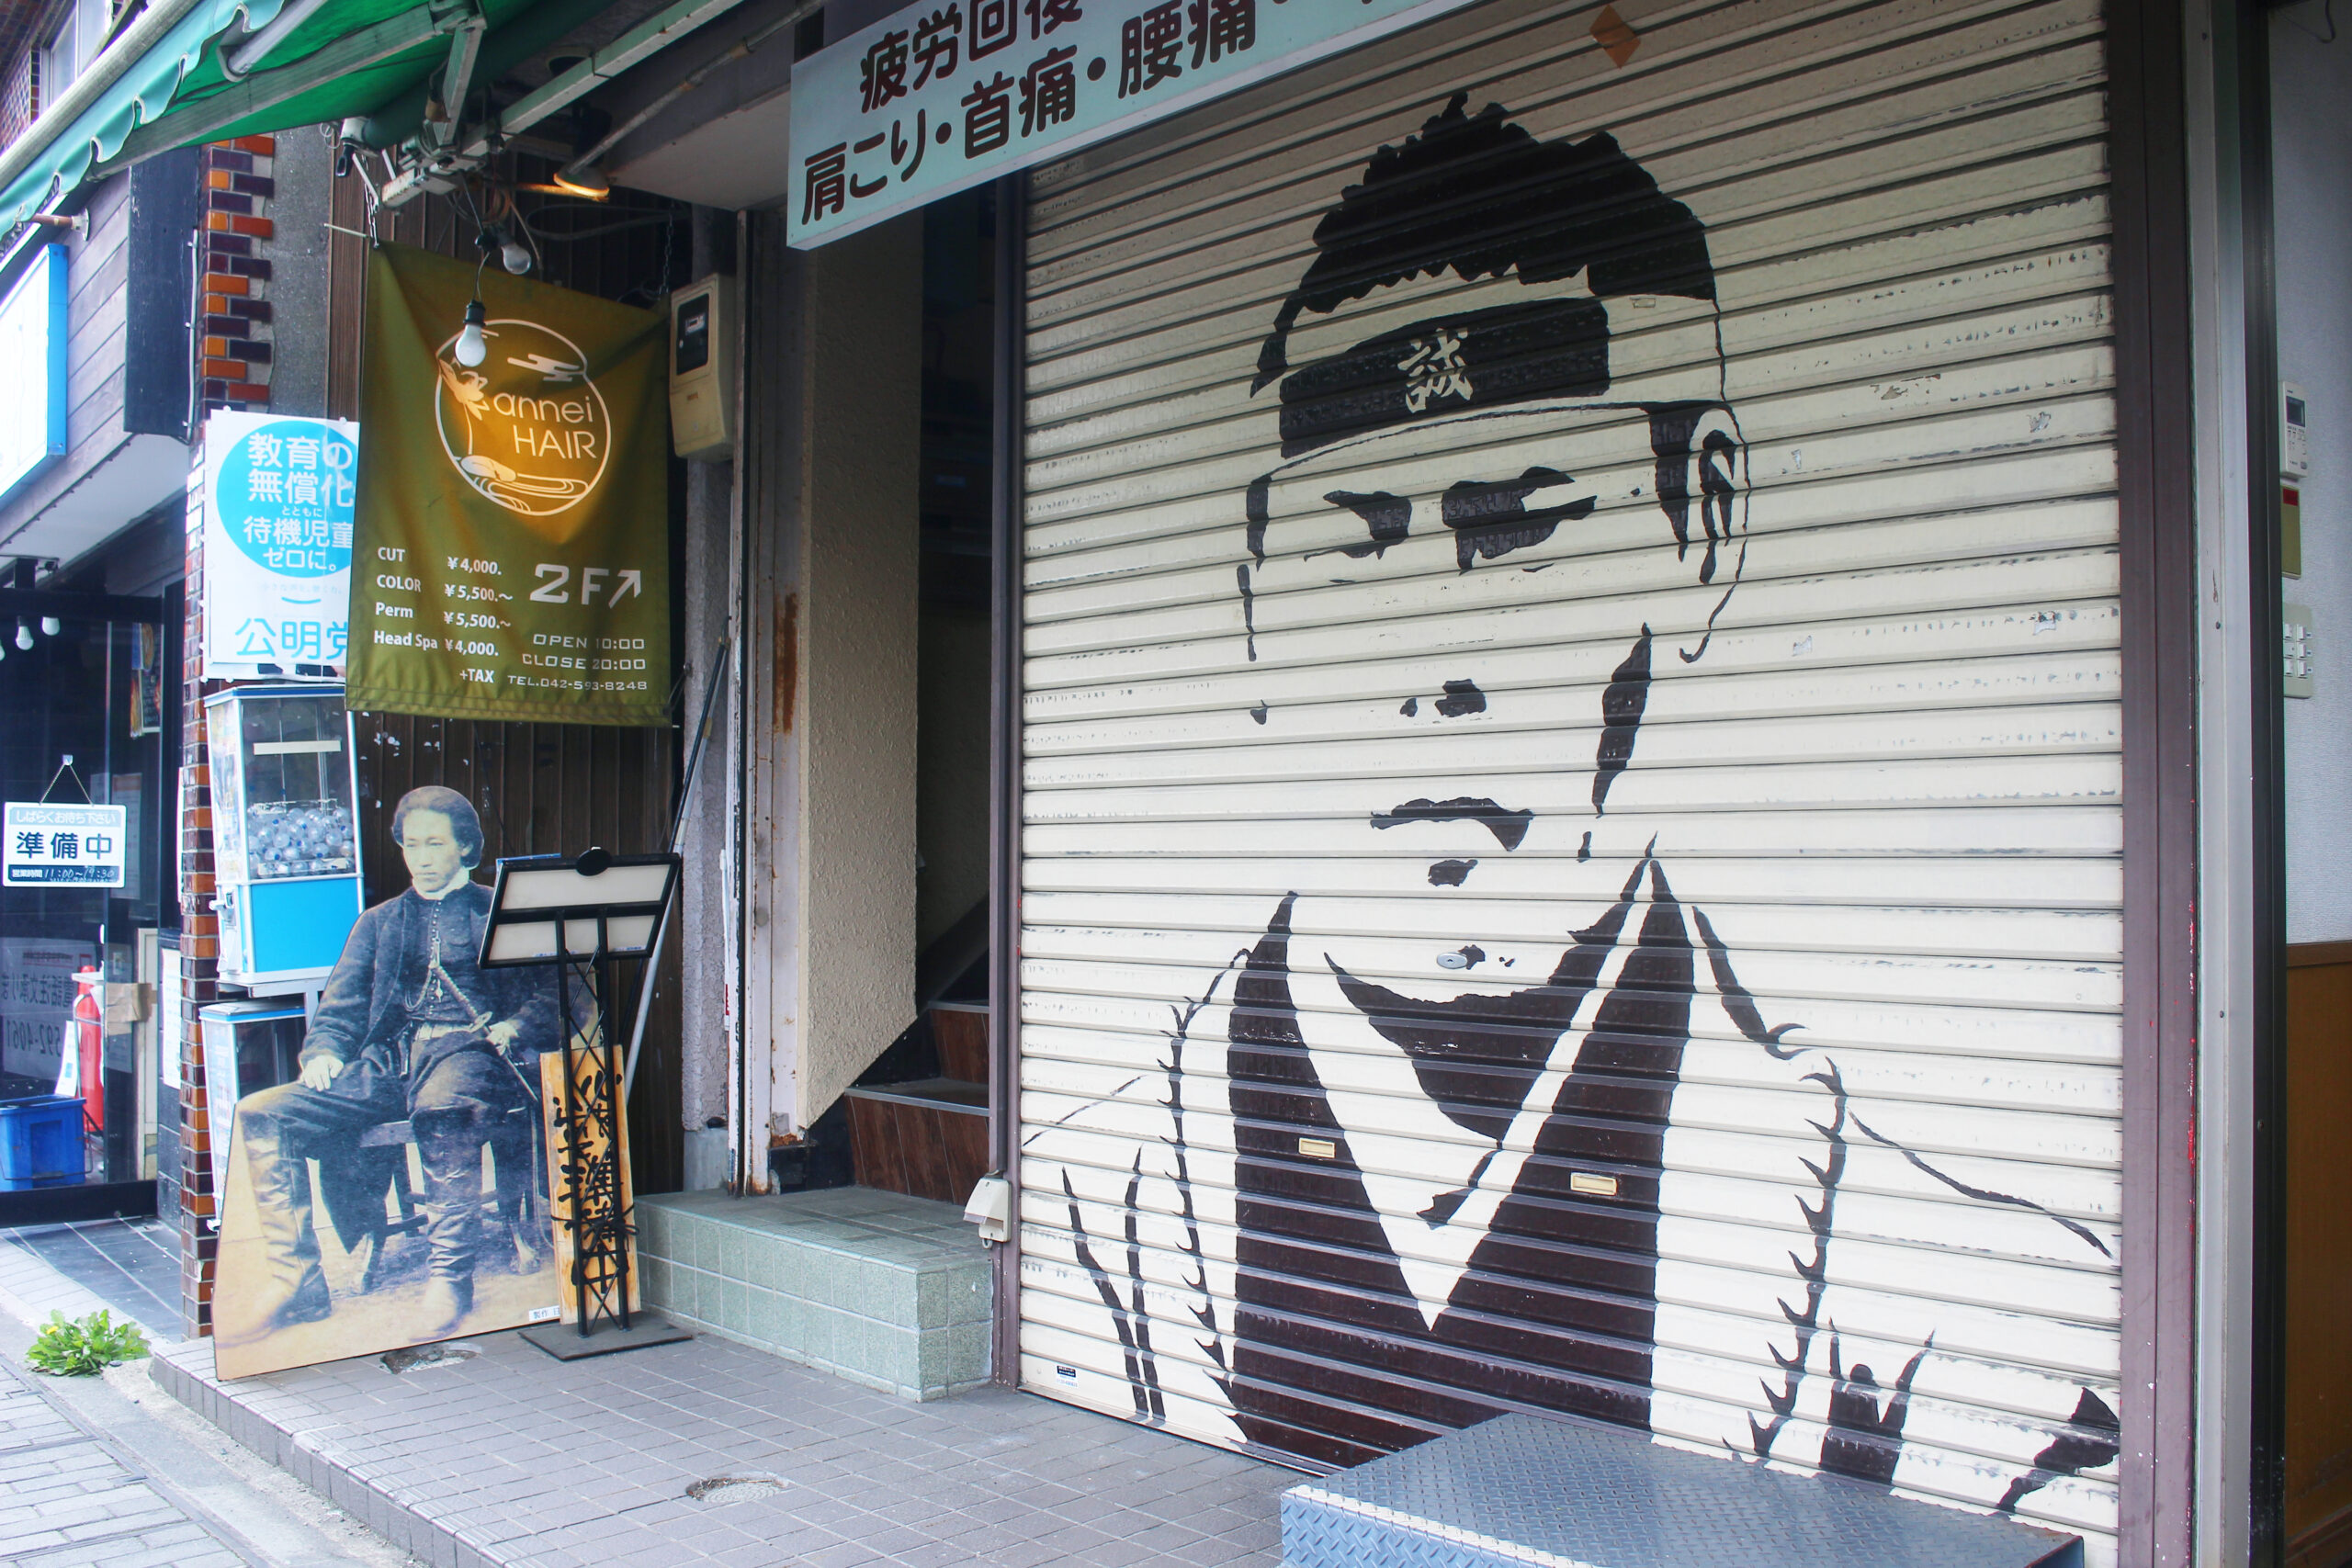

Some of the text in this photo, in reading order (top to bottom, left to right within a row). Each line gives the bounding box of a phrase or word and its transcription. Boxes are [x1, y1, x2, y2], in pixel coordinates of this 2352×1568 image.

[513, 424, 597, 459] HAIR
[247, 432, 354, 471] 教育の
[247, 468, 355, 508] 無償化
[281, 506, 322, 518] とともに
[243, 516, 354, 549] 待機児童
[378, 547, 405, 562] CUT
[376, 574, 422, 592] COLOR
[375, 602, 413, 618] Perm
[373, 630, 413, 646] Head
[414, 634, 438, 651] Spa
[533, 634, 645, 650] OPEN 10:00
[522, 653, 647, 671] CLOSE 20:00
[459, 668, 495, 683] +TAX
[507, 675, 648, 691] TEL.042-593-8248
[16, 810, 117, 824] しばらくお待ち下さい
[17, 831, 112, 860] 準備中
